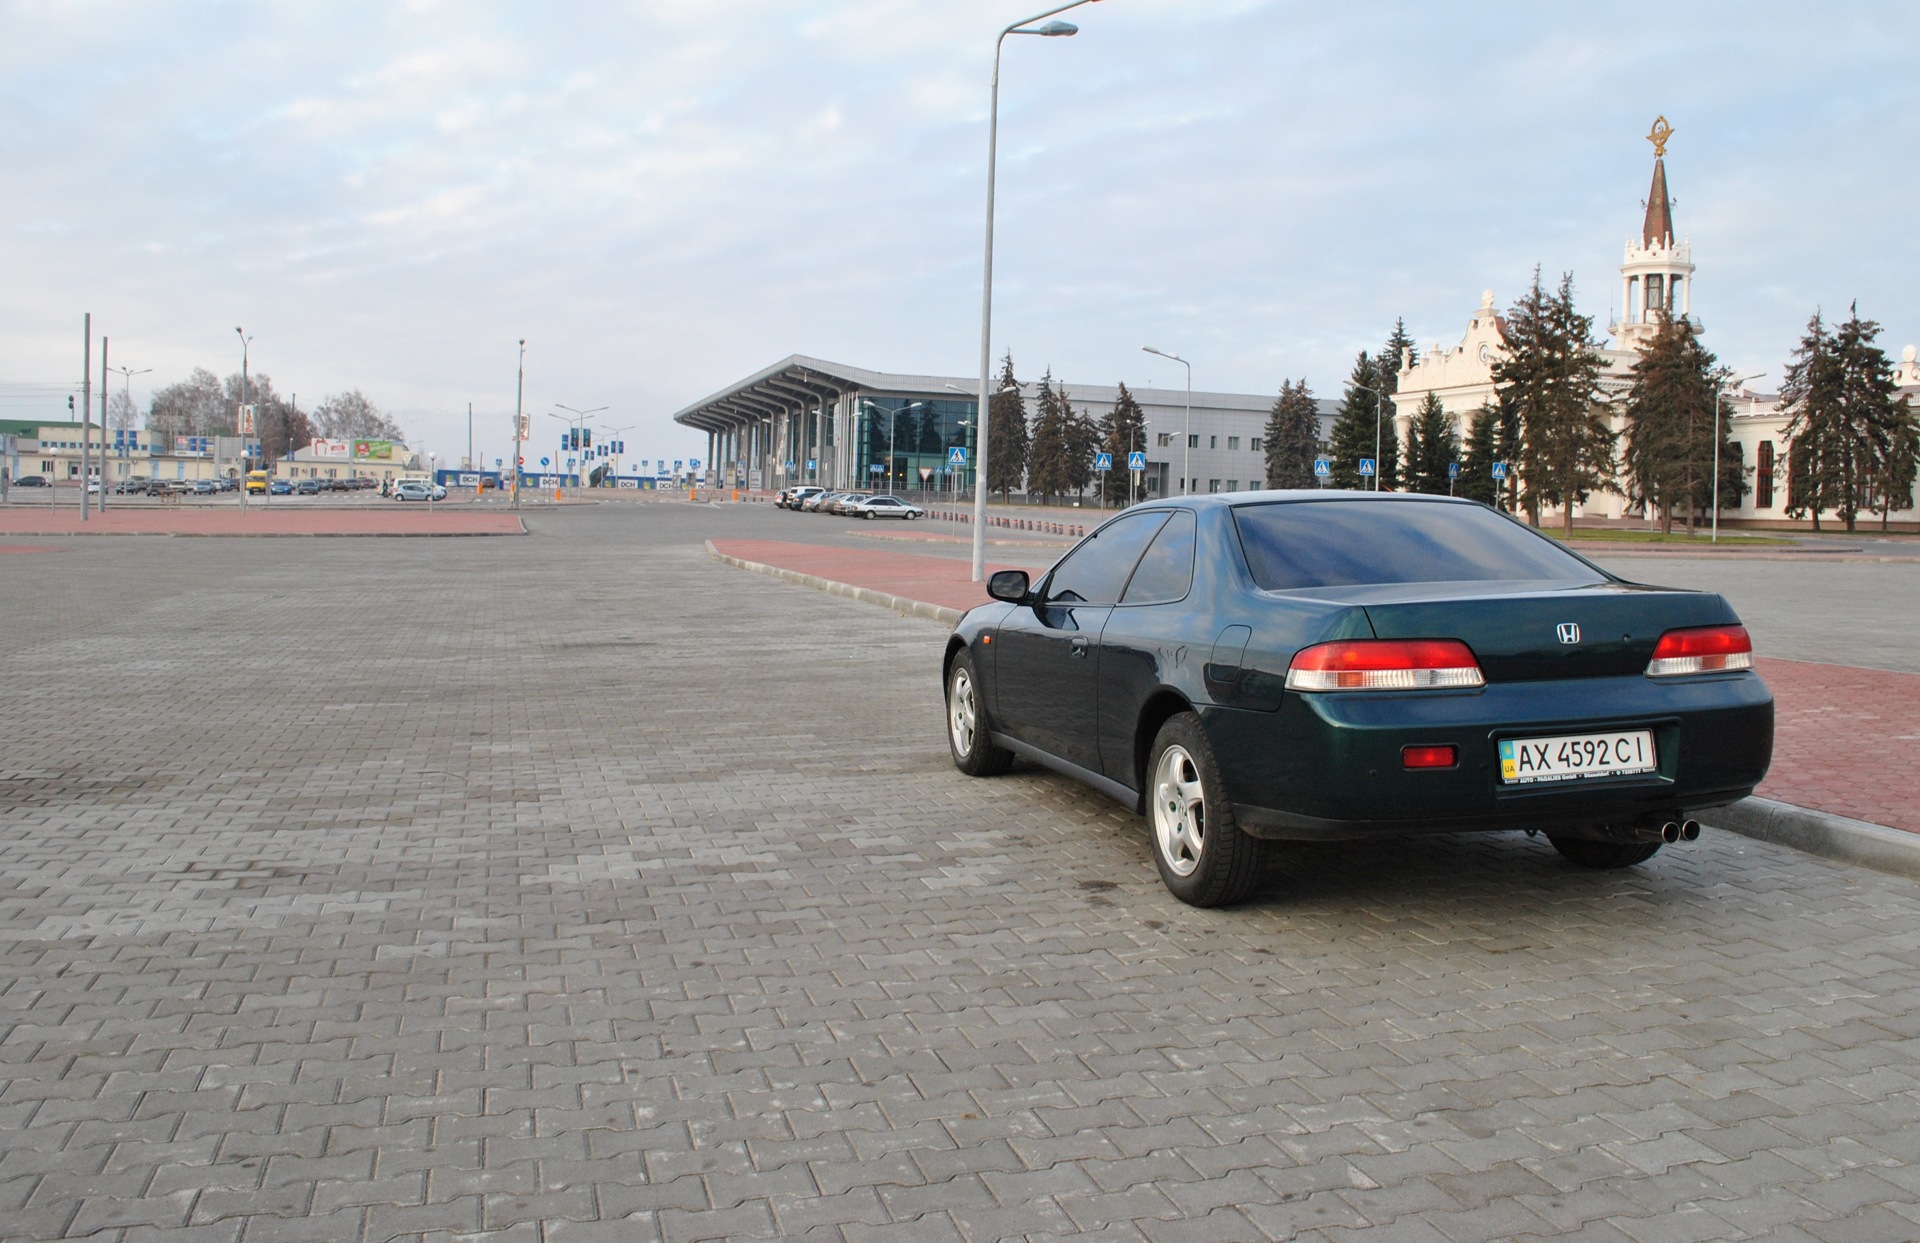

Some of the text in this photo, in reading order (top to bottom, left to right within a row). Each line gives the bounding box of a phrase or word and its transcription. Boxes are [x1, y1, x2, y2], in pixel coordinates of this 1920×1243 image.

[1519, 743, 1551, 772] AX
[1557, 739, 1610, 768] 4592
[1504, 765, 1515, 773] UA
